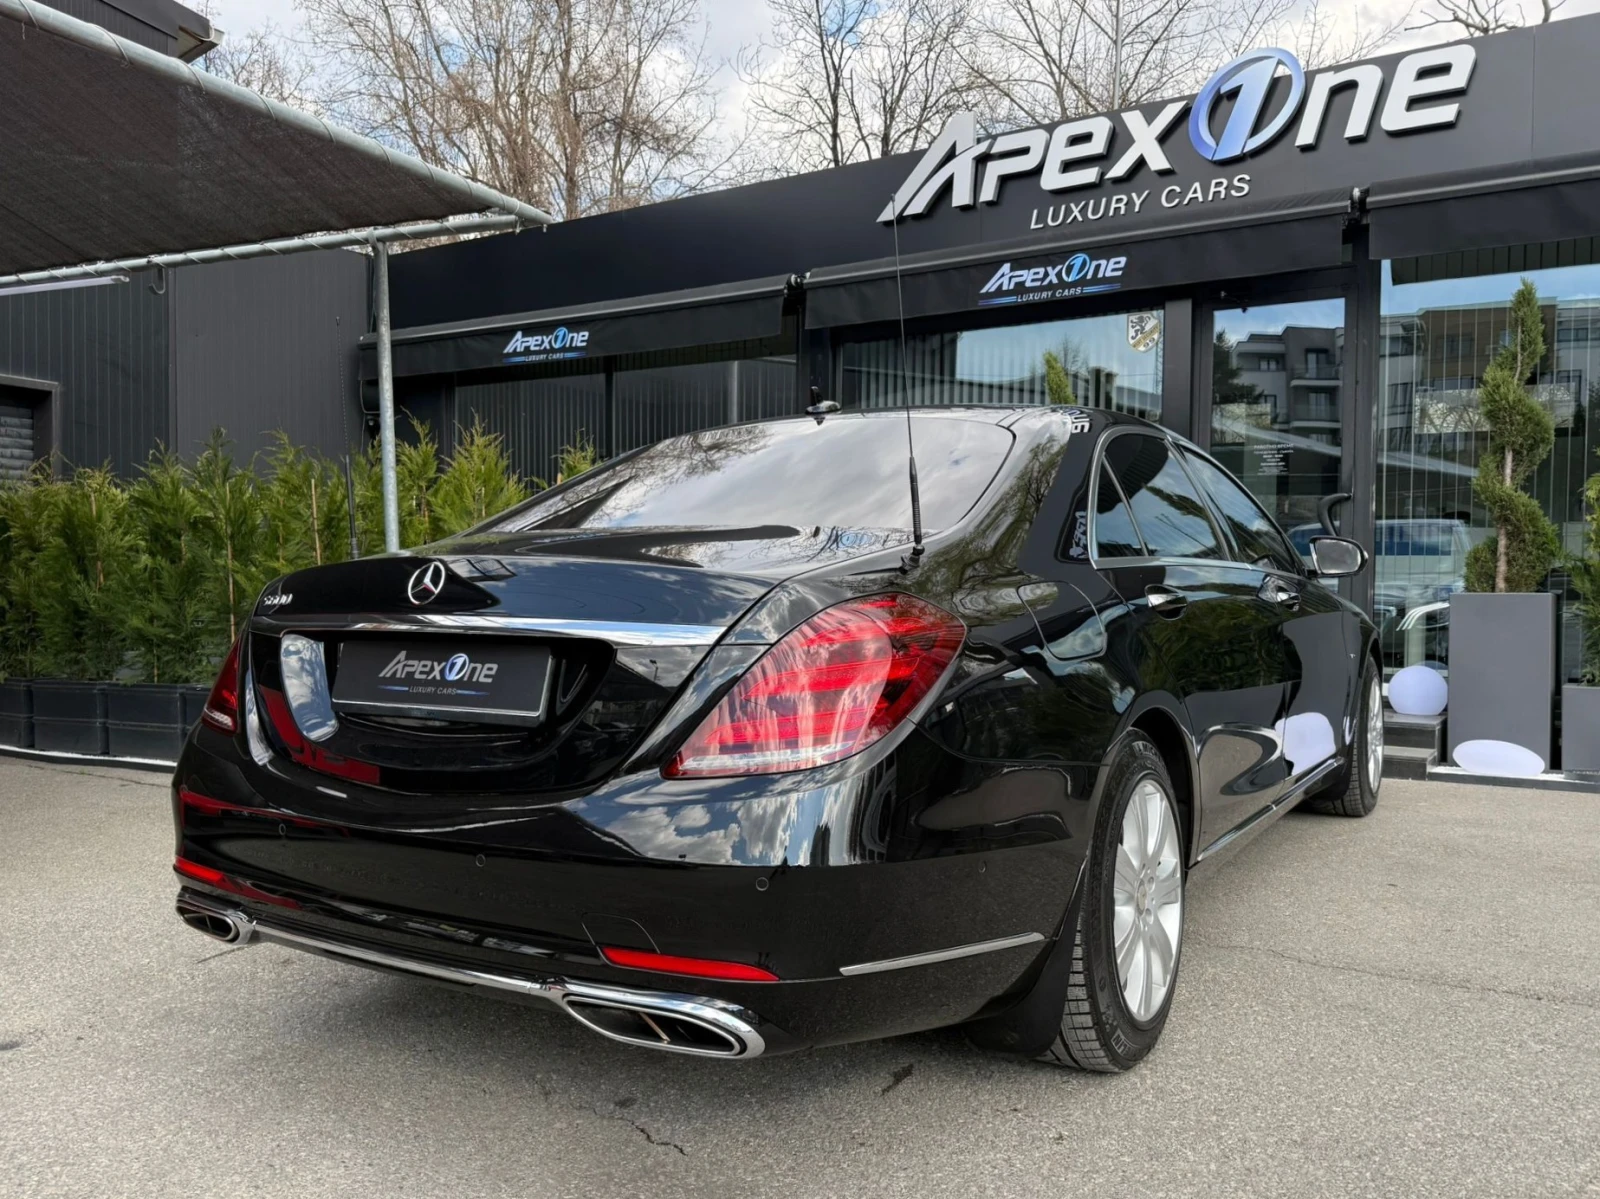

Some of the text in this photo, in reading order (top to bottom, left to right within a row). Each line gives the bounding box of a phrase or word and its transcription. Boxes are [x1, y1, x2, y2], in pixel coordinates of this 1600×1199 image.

[1030, 173, 1251, 230] LUXURY CARS
[1017, 286, 1082, 302] LUXURY CARS
[548, 352, 564, 360] CARS
[409, 685, 457, 696] LUXURY CARS
